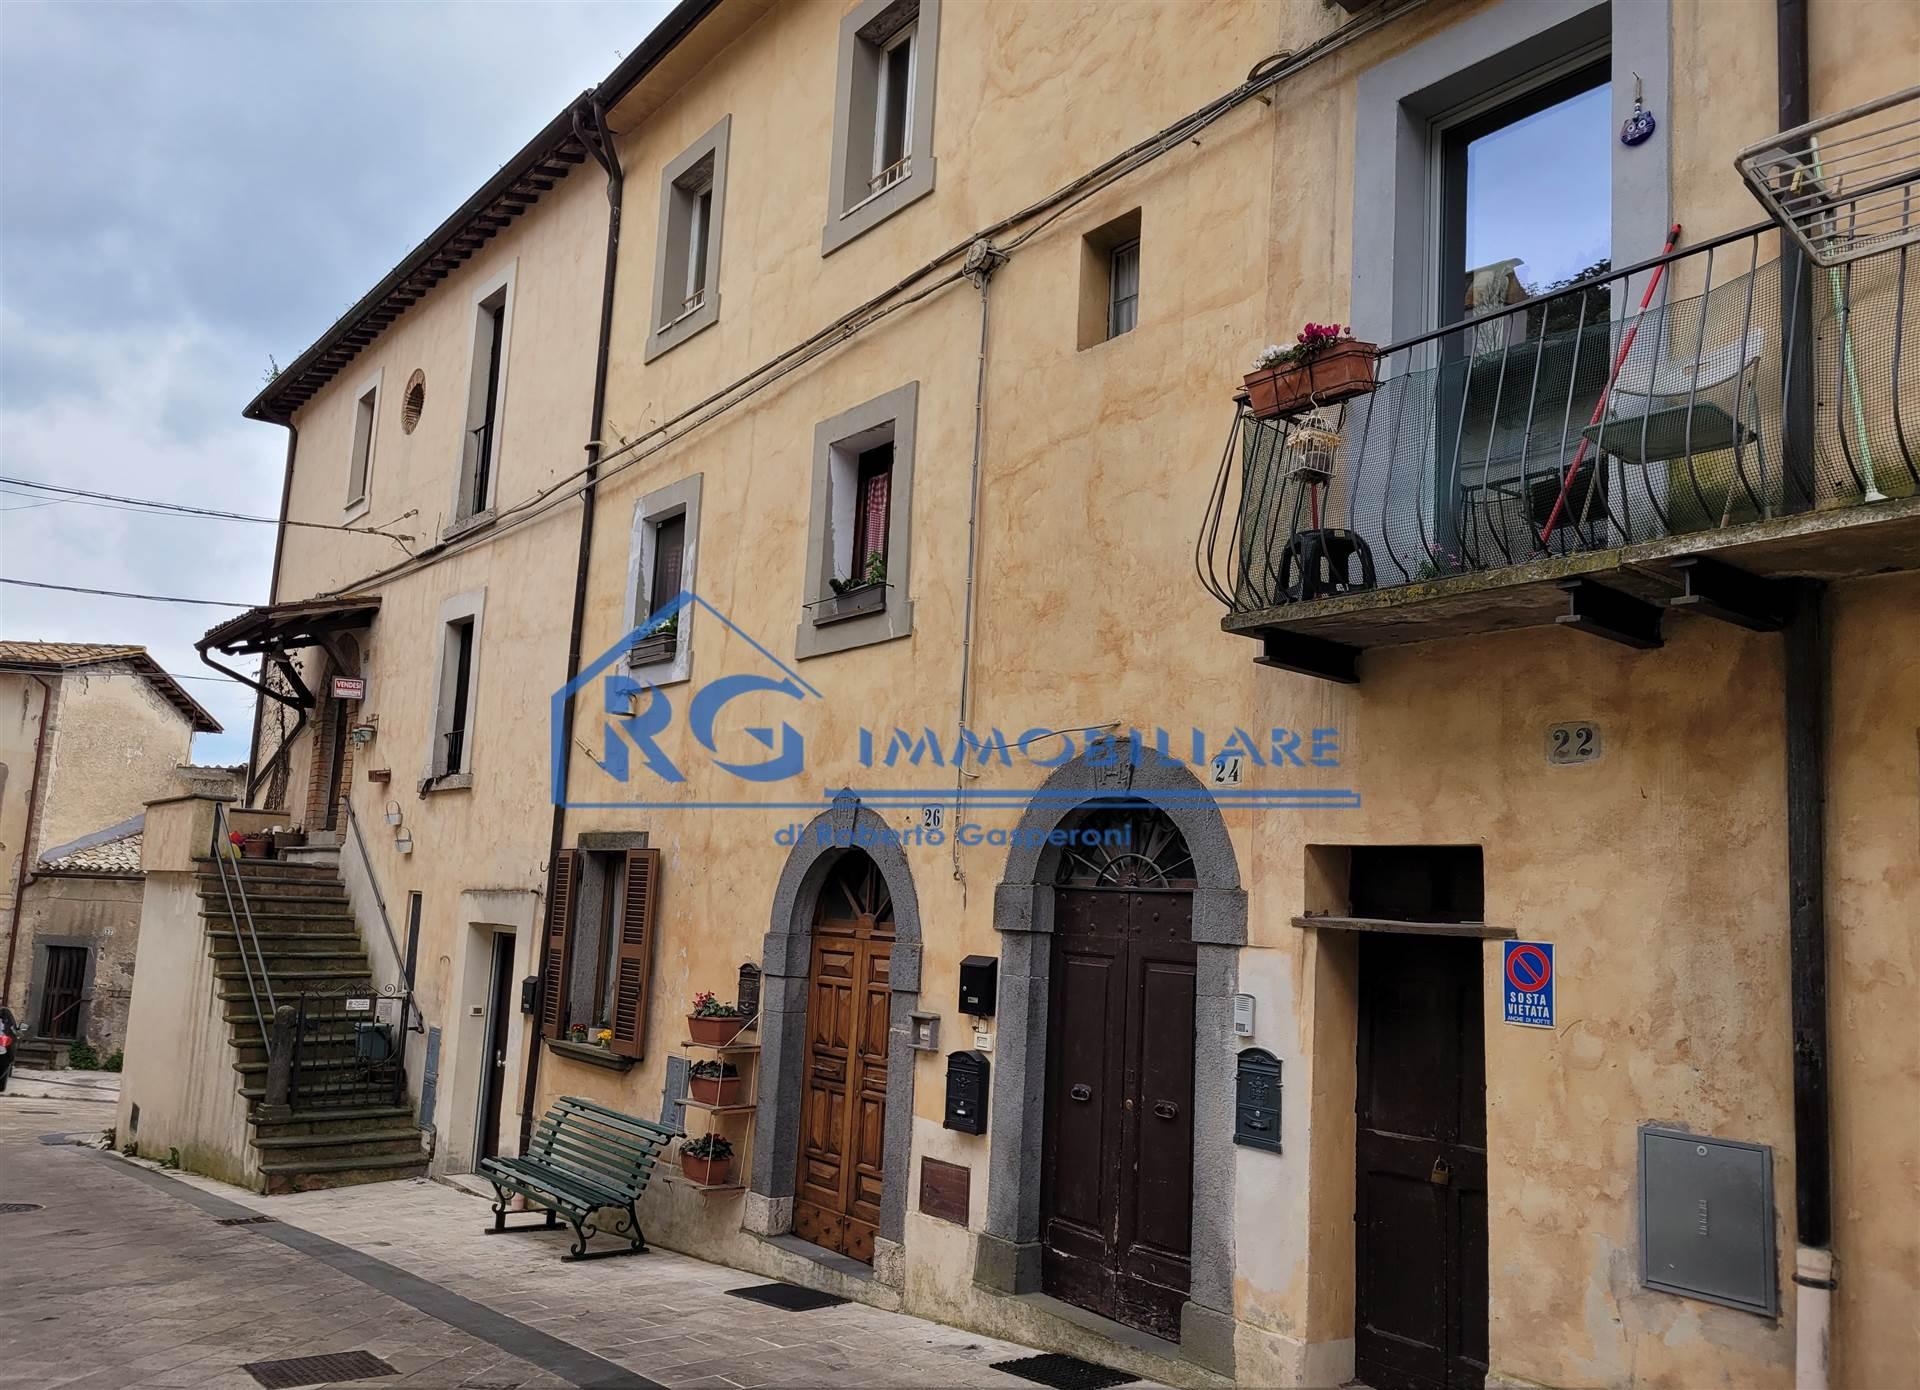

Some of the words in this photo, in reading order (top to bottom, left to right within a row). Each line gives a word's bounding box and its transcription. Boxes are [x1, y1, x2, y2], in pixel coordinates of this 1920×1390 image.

[1553, 727, 1593, 758] 22
[1215, 758, 1239, 783] 24
[925, 808, 940, 827] 26
[1510, 991, 1547, 1006] SOSTA
[1508, 1003, 1550, 1018] VIETATA
